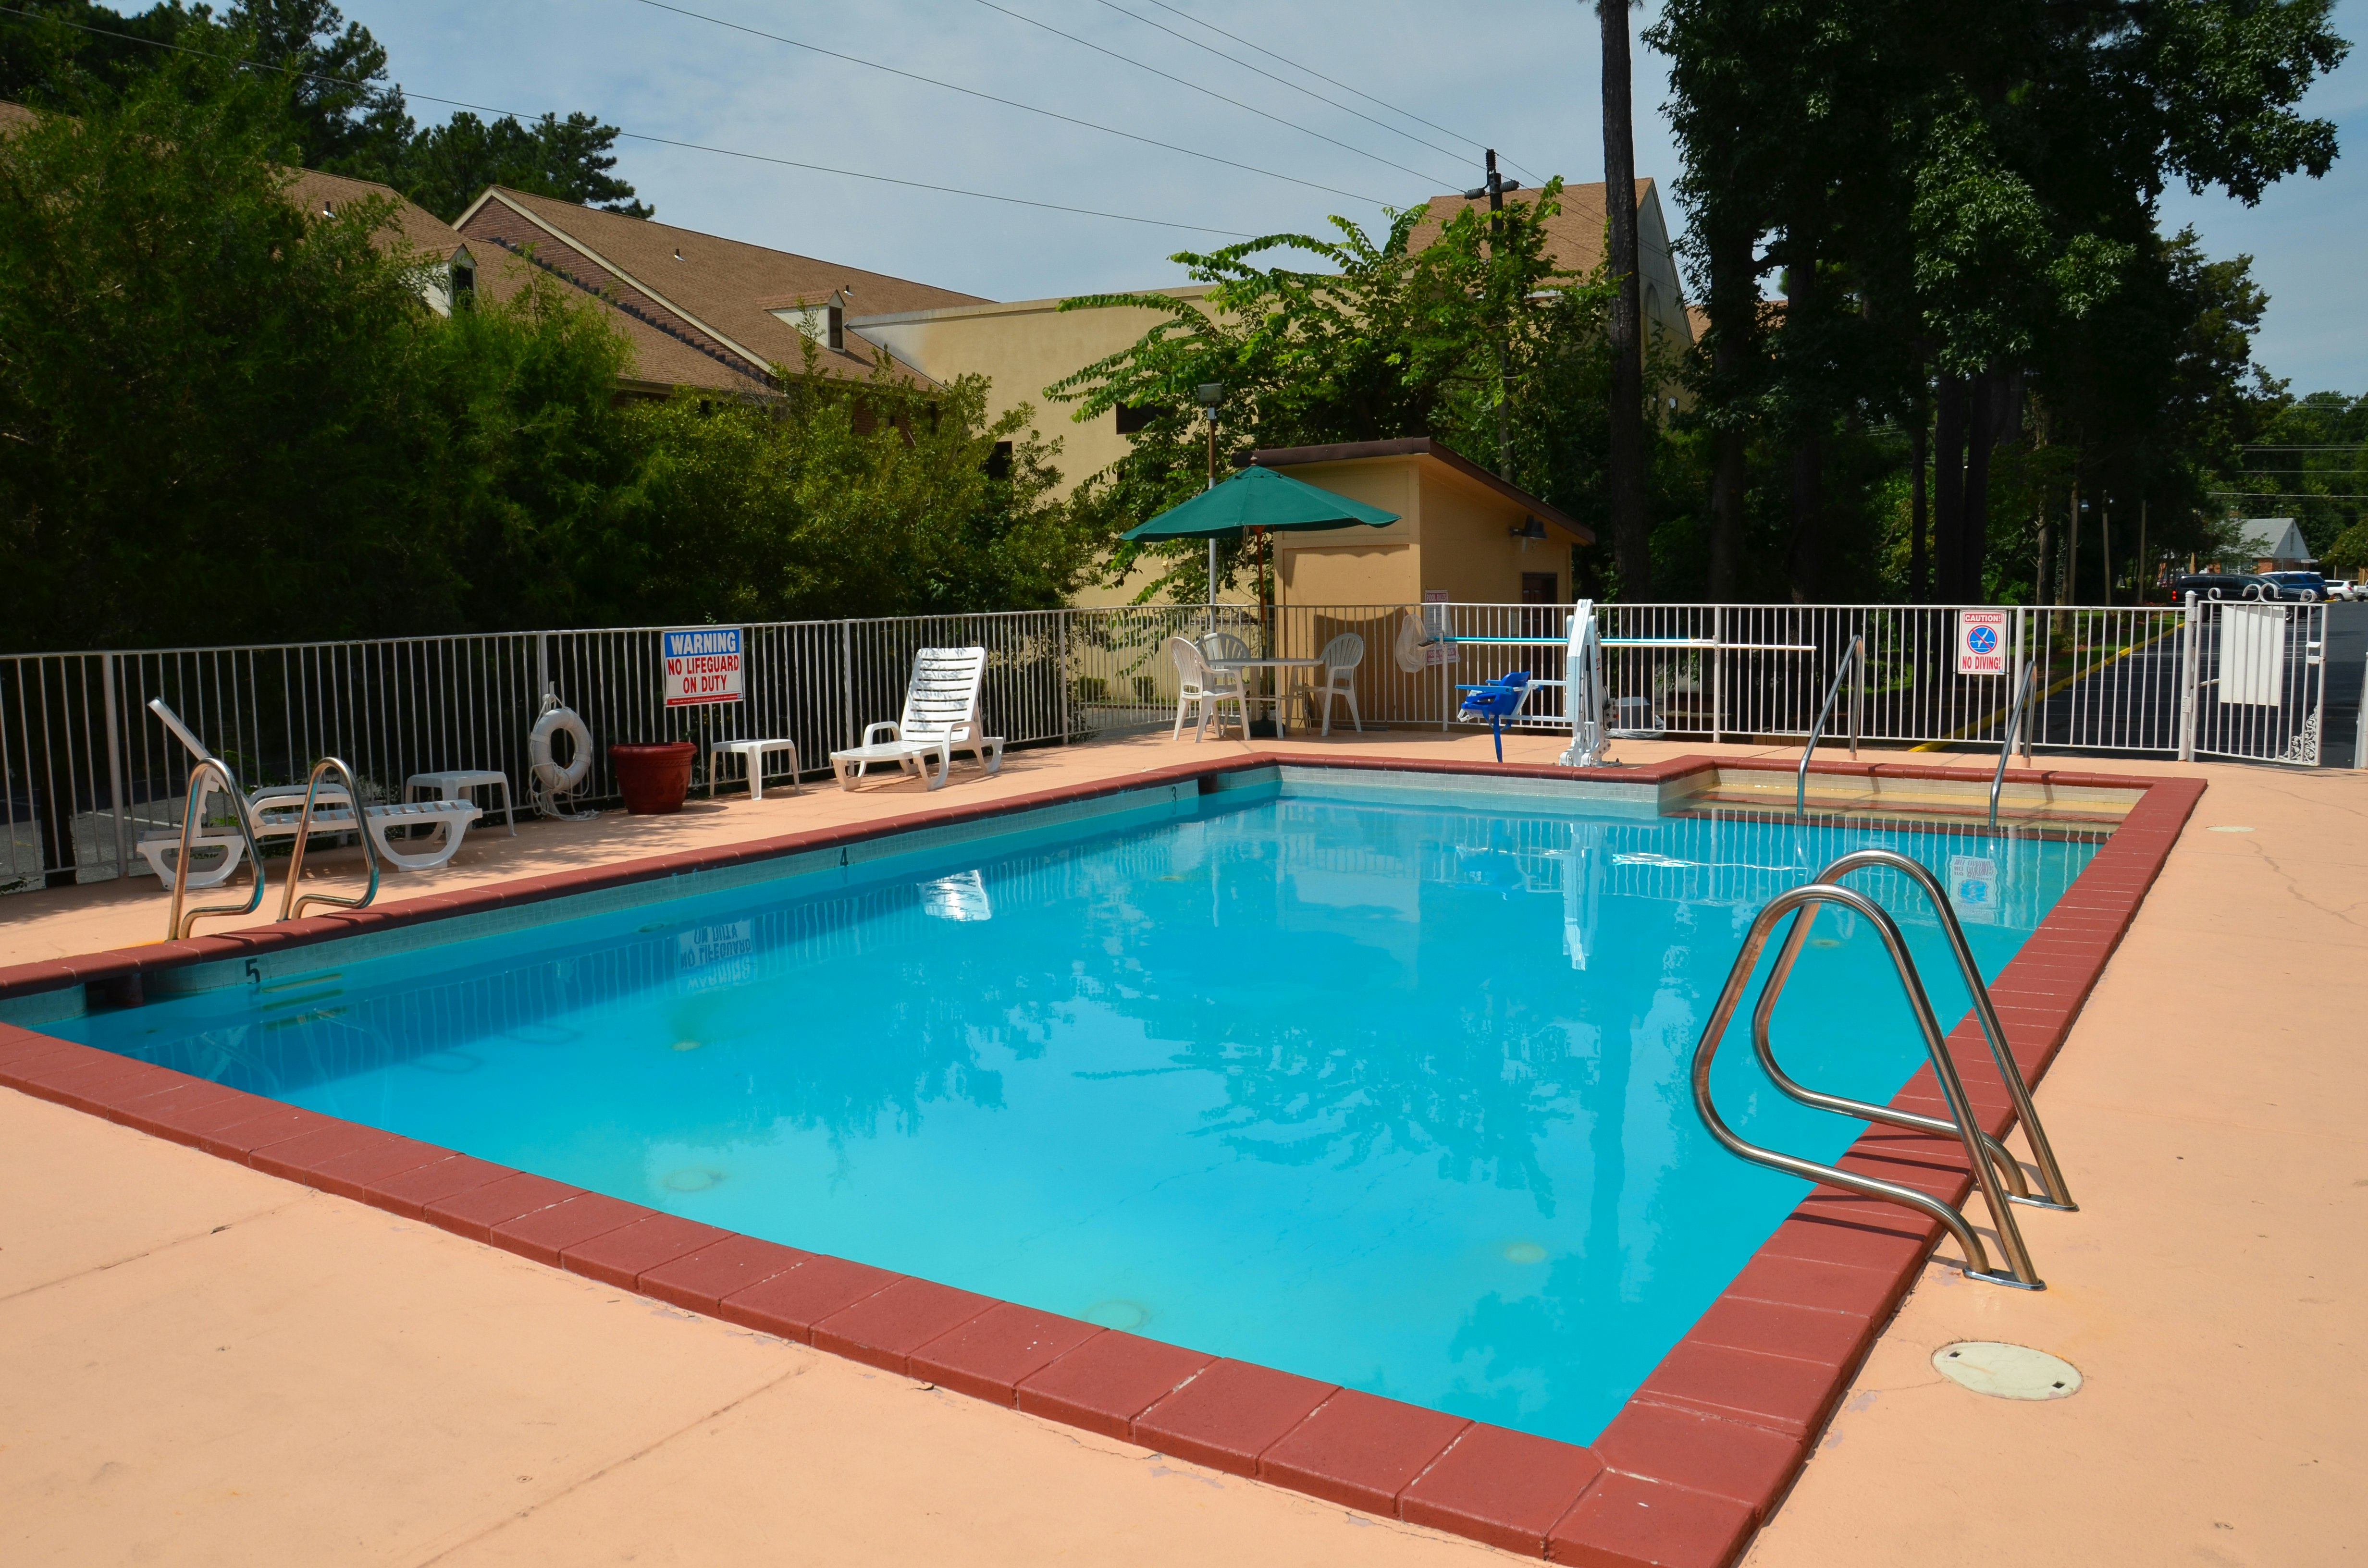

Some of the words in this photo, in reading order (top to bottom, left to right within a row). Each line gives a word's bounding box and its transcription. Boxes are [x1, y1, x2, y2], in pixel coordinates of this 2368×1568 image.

[670, 632, 736, 655] WARNING
[667, 658, 682, 675] NO
[687, 655, 739, 674] LIFEGUARD
[1962, 656, 1972, 669] NO
[1975, 656, 2001, 670] DIVING!
[683, 677, 696, 694] ON
[702, 674, 727, 692] DUTY
[1172, 786, 1177, 802] 3
[840, 847, 849, 867] 4
[245, 958, 260, 984] 5
